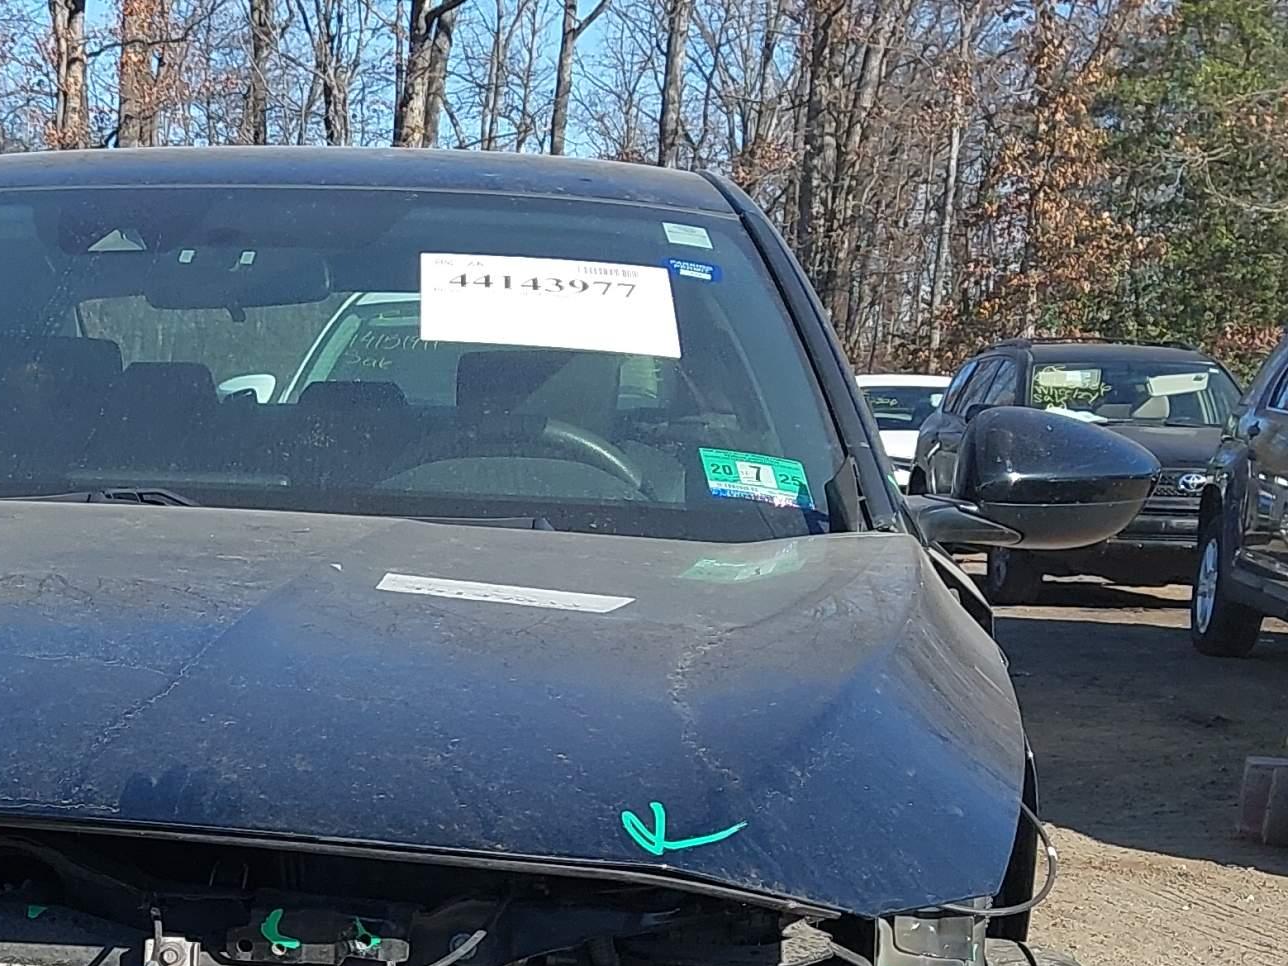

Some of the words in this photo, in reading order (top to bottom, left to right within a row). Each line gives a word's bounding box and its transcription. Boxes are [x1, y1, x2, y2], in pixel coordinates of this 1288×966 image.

[448, 272, 637, 298] 44143977
[710, 463, 733, 476] 20
[748, 465, 762, 482] 7
[778, 473, 803, 487] 25
